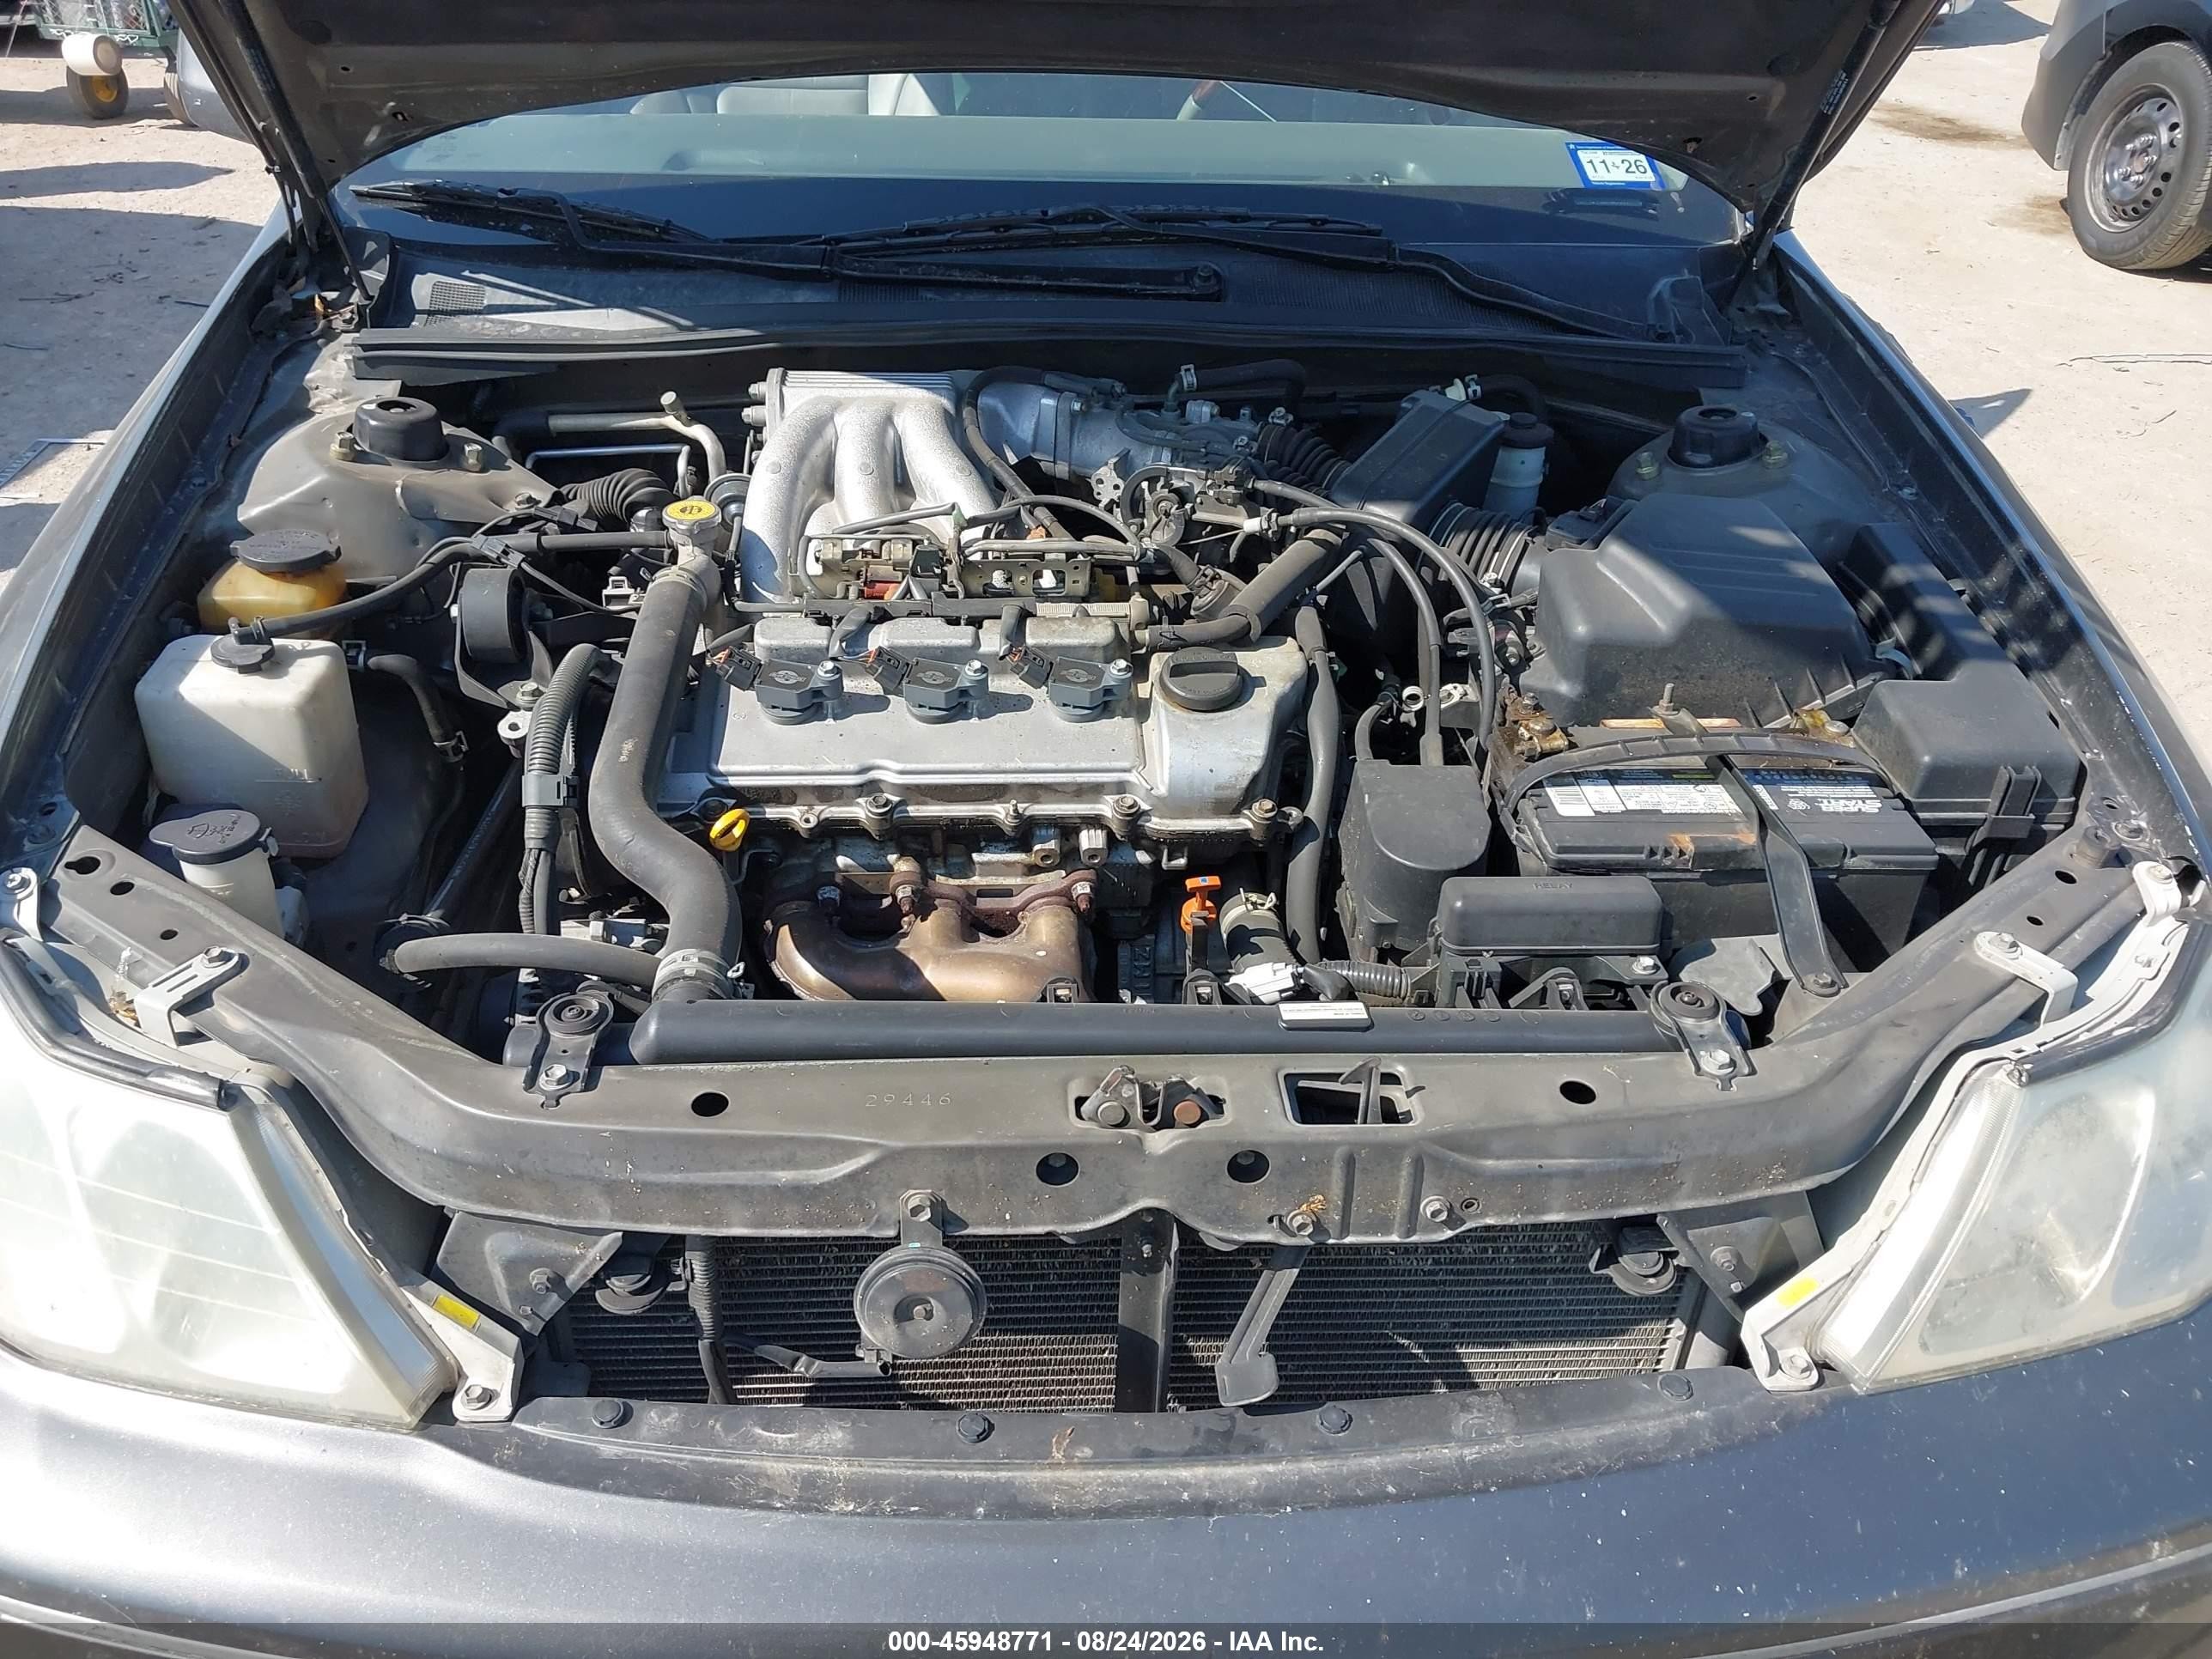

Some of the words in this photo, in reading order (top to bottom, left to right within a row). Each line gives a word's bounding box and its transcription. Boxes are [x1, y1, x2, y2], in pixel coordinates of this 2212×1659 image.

[1587, 159, 1612, 174] 11
[1620, 159, 1648, 174] 26
[1820, 805, 1880, 813] SUPER
[865, 1092, 951, 1107] 29446
